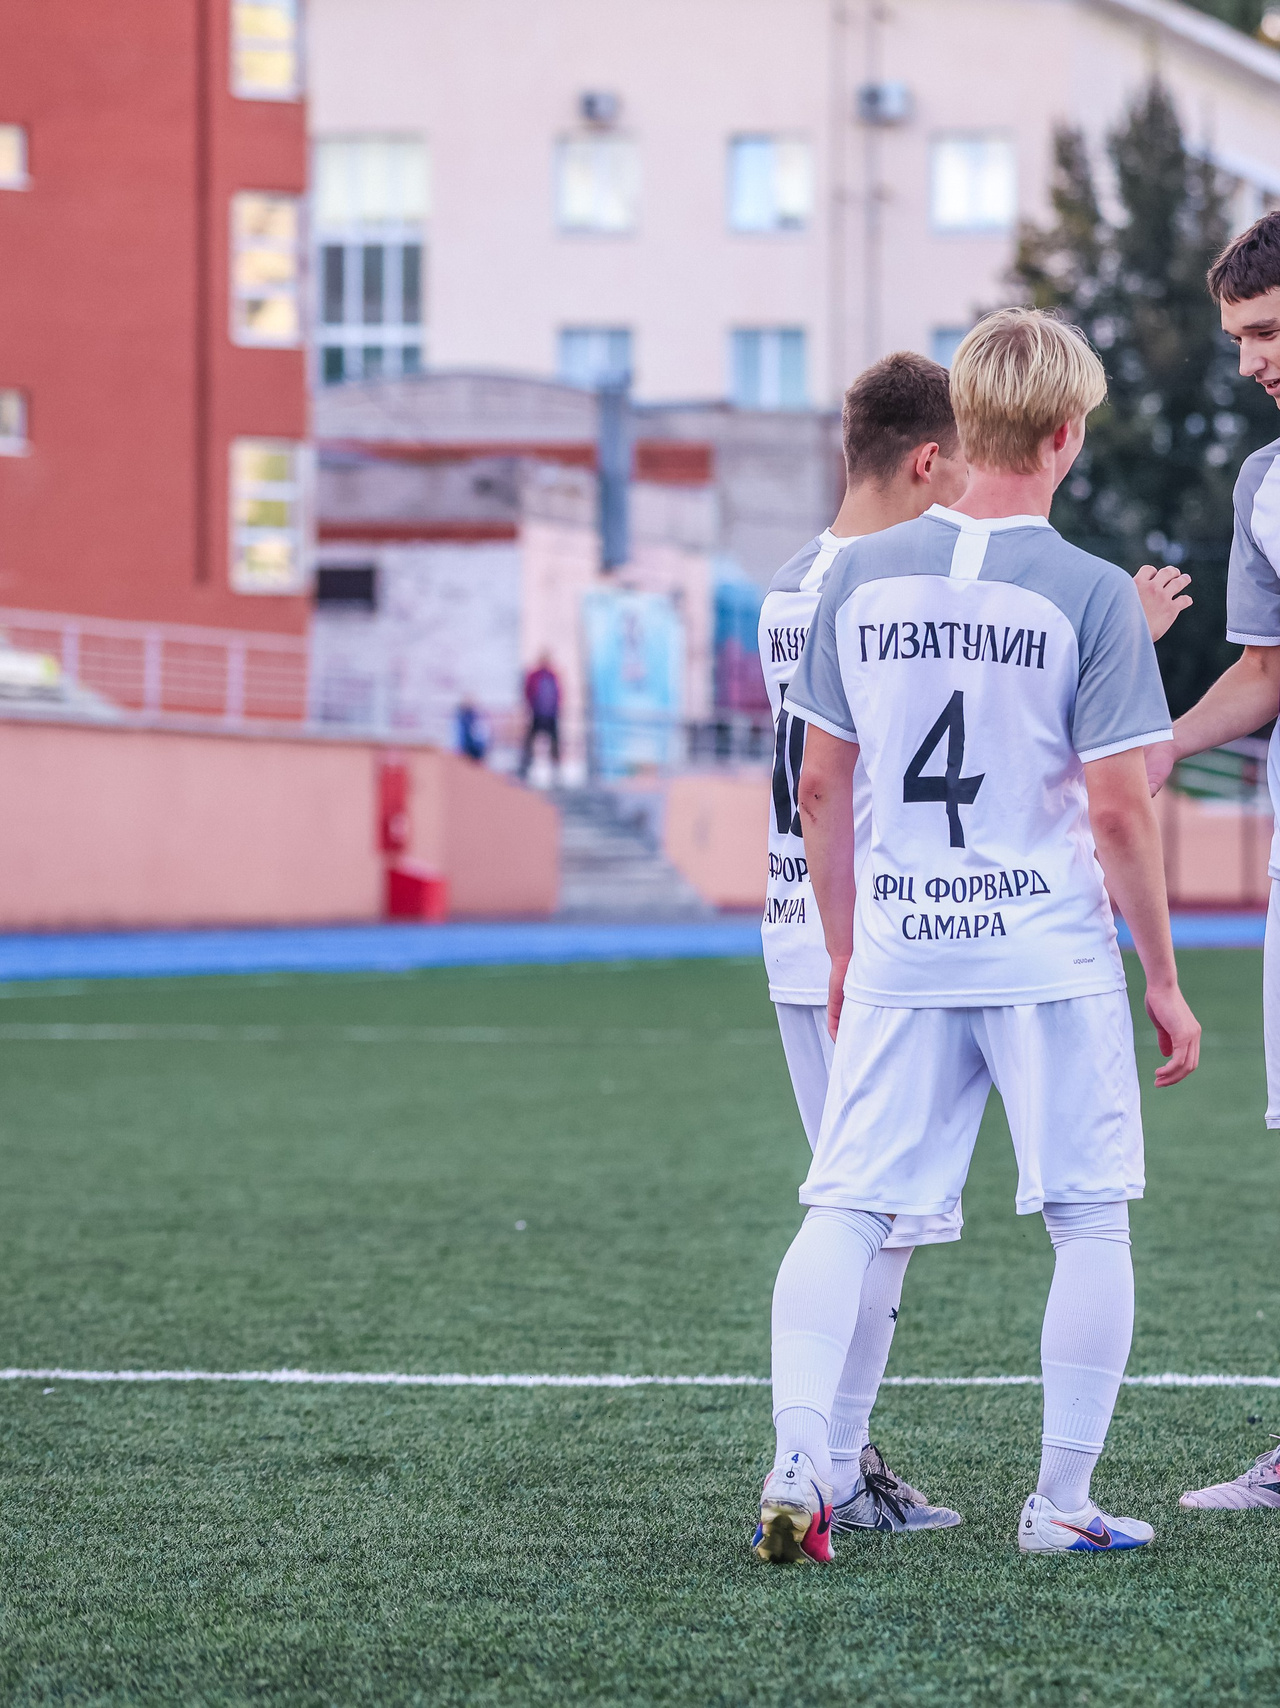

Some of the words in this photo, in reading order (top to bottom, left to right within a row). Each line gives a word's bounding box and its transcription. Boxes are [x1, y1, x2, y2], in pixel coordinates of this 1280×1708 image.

[858, 621, 1047, 669] ГИЗАТУЛИН
[902, 690, 986, 849] 4
[768, 852, 811, 883] ФОР
[924, 869, 1051, 904] ФОРВАРД
[901, 911, 1007, 941] САМАРА
[791, 1453, 800, 1464] 4
[1029, 1497, 1036, 1510] 4
